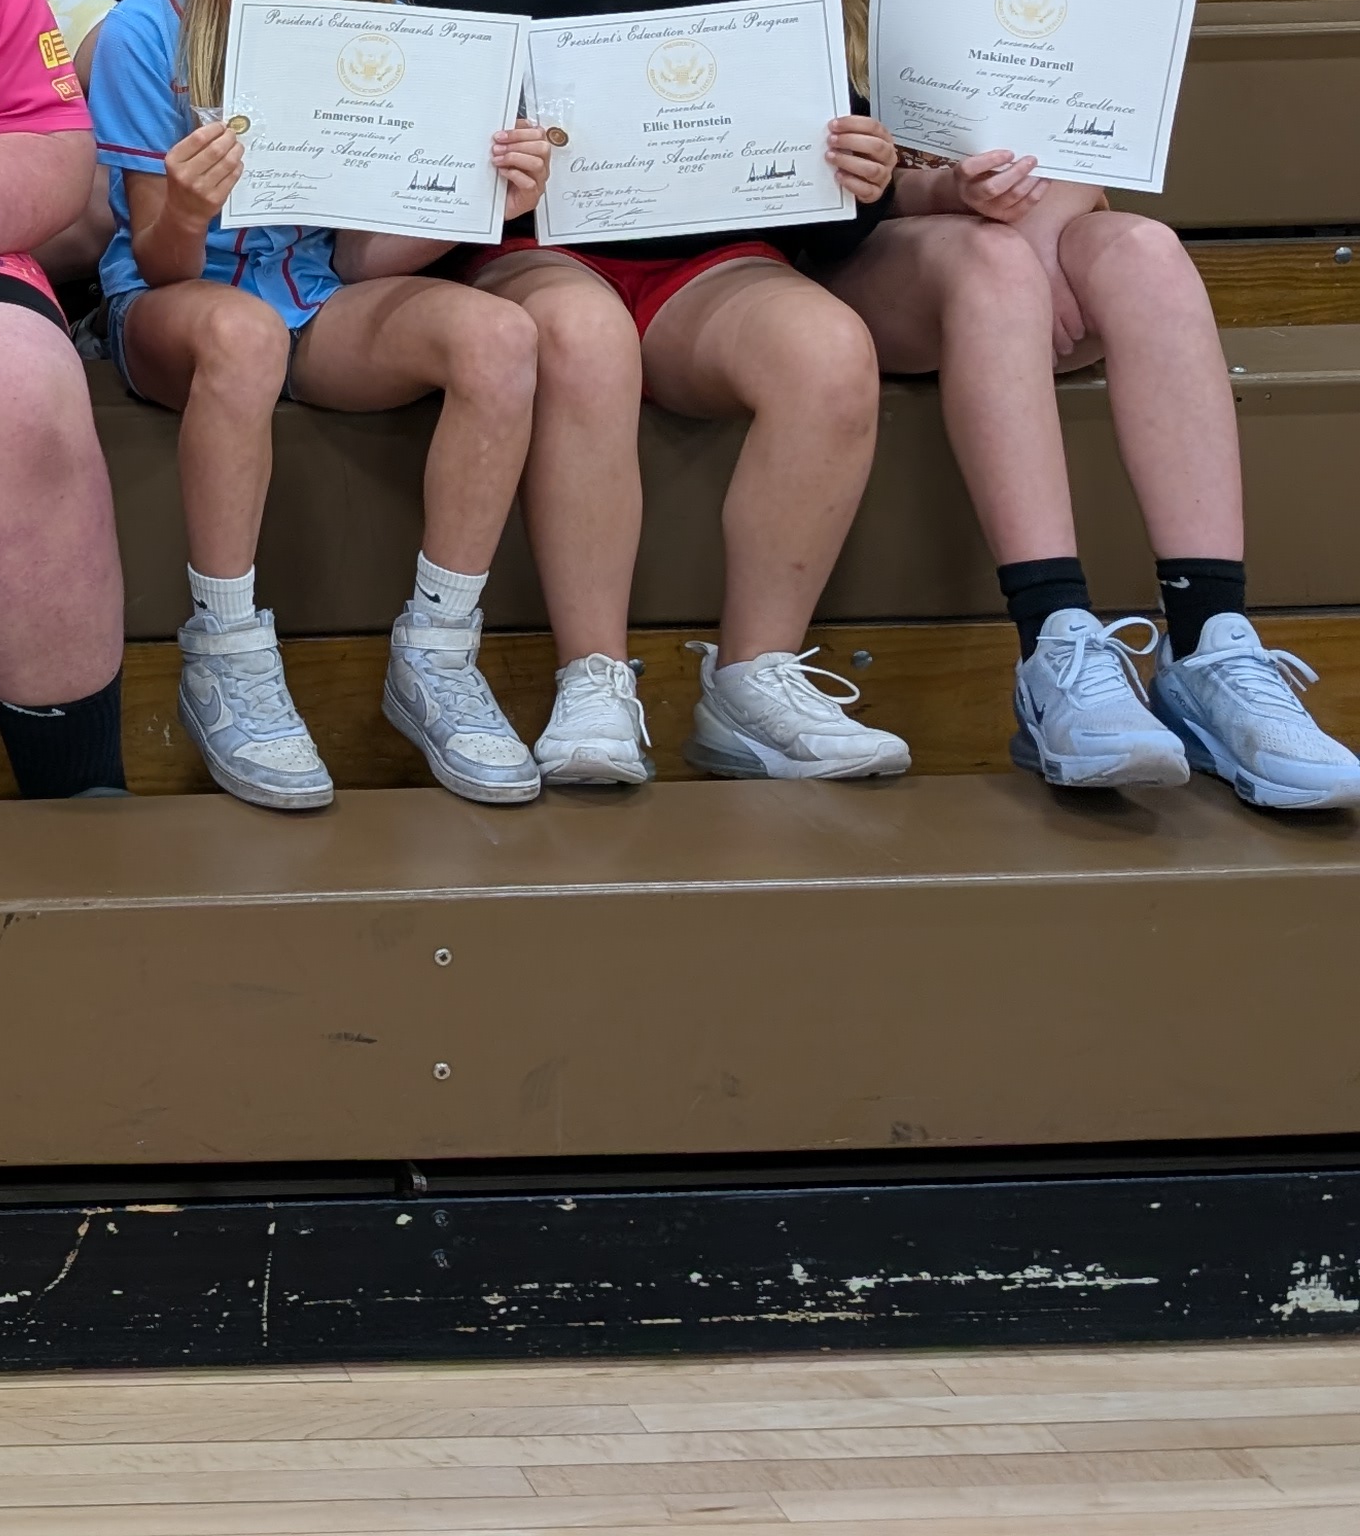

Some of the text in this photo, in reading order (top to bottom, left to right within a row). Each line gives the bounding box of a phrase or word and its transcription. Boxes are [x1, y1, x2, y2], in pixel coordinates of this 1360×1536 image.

[264, 7, 492, 46] President's Education Awards Program
[556, 11, 798, 48] President's Education Awards Program
[968, 49, 1073, 71] Makinlee Darnell
[898, 67, 1134, 114] Outstanding Academic Excellence
[1000, 100, 1029, 111] 2026
[313, 109, 414, 129] Emmerson Lange
[642, 115, 731, 132] Ellie Hornstein
[331, 140, 399, 161] Academic
[408, 148, 475, 168] Excellence
[342, 157, 370, 168] 2026
[570, 140, 811, 172] Outstanding Academic Excellence
[676, 162, 705, 174] 2026
